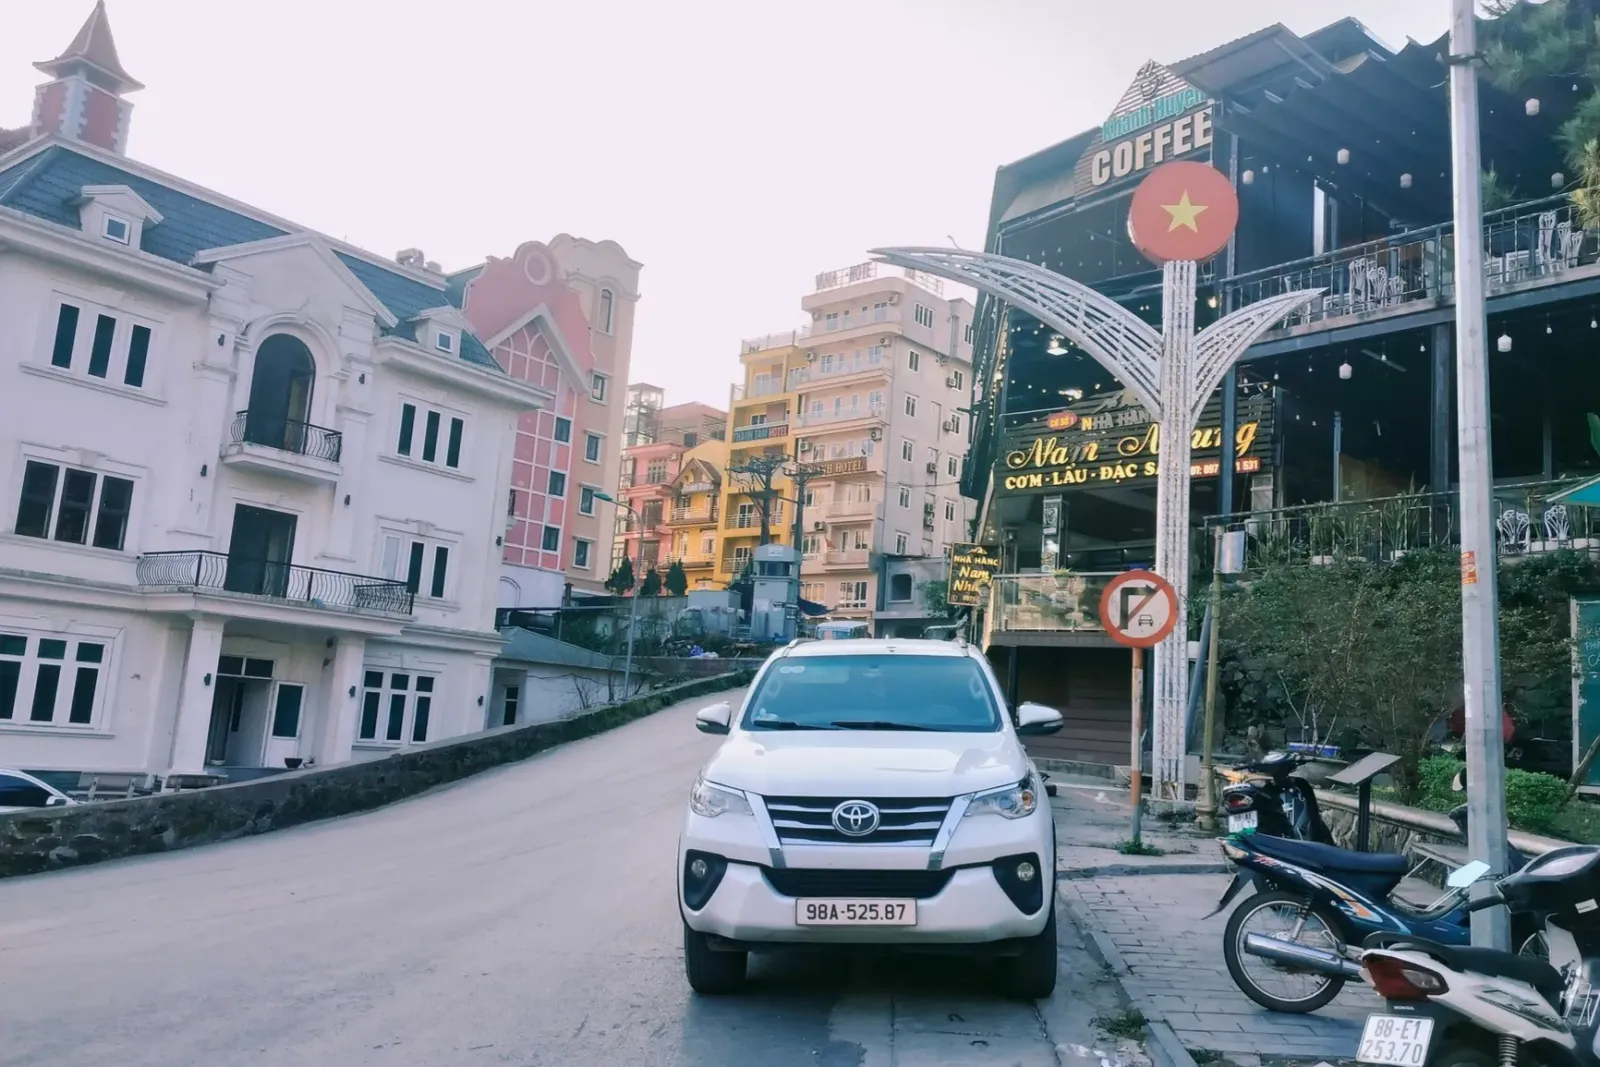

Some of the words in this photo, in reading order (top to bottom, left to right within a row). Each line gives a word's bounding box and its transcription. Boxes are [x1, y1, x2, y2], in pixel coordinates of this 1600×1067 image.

[1091, 106, 1213, 186] COFFEE
[1006, 436, 1099, 470] Nam
[835, 460, 864, 474] HOTEL
[806, 904, 906, 921] 98A-525.87
[1374, 1019, 1422, 1041] 88-E1
[1361, 1039, 1423, 1064] 253.70
